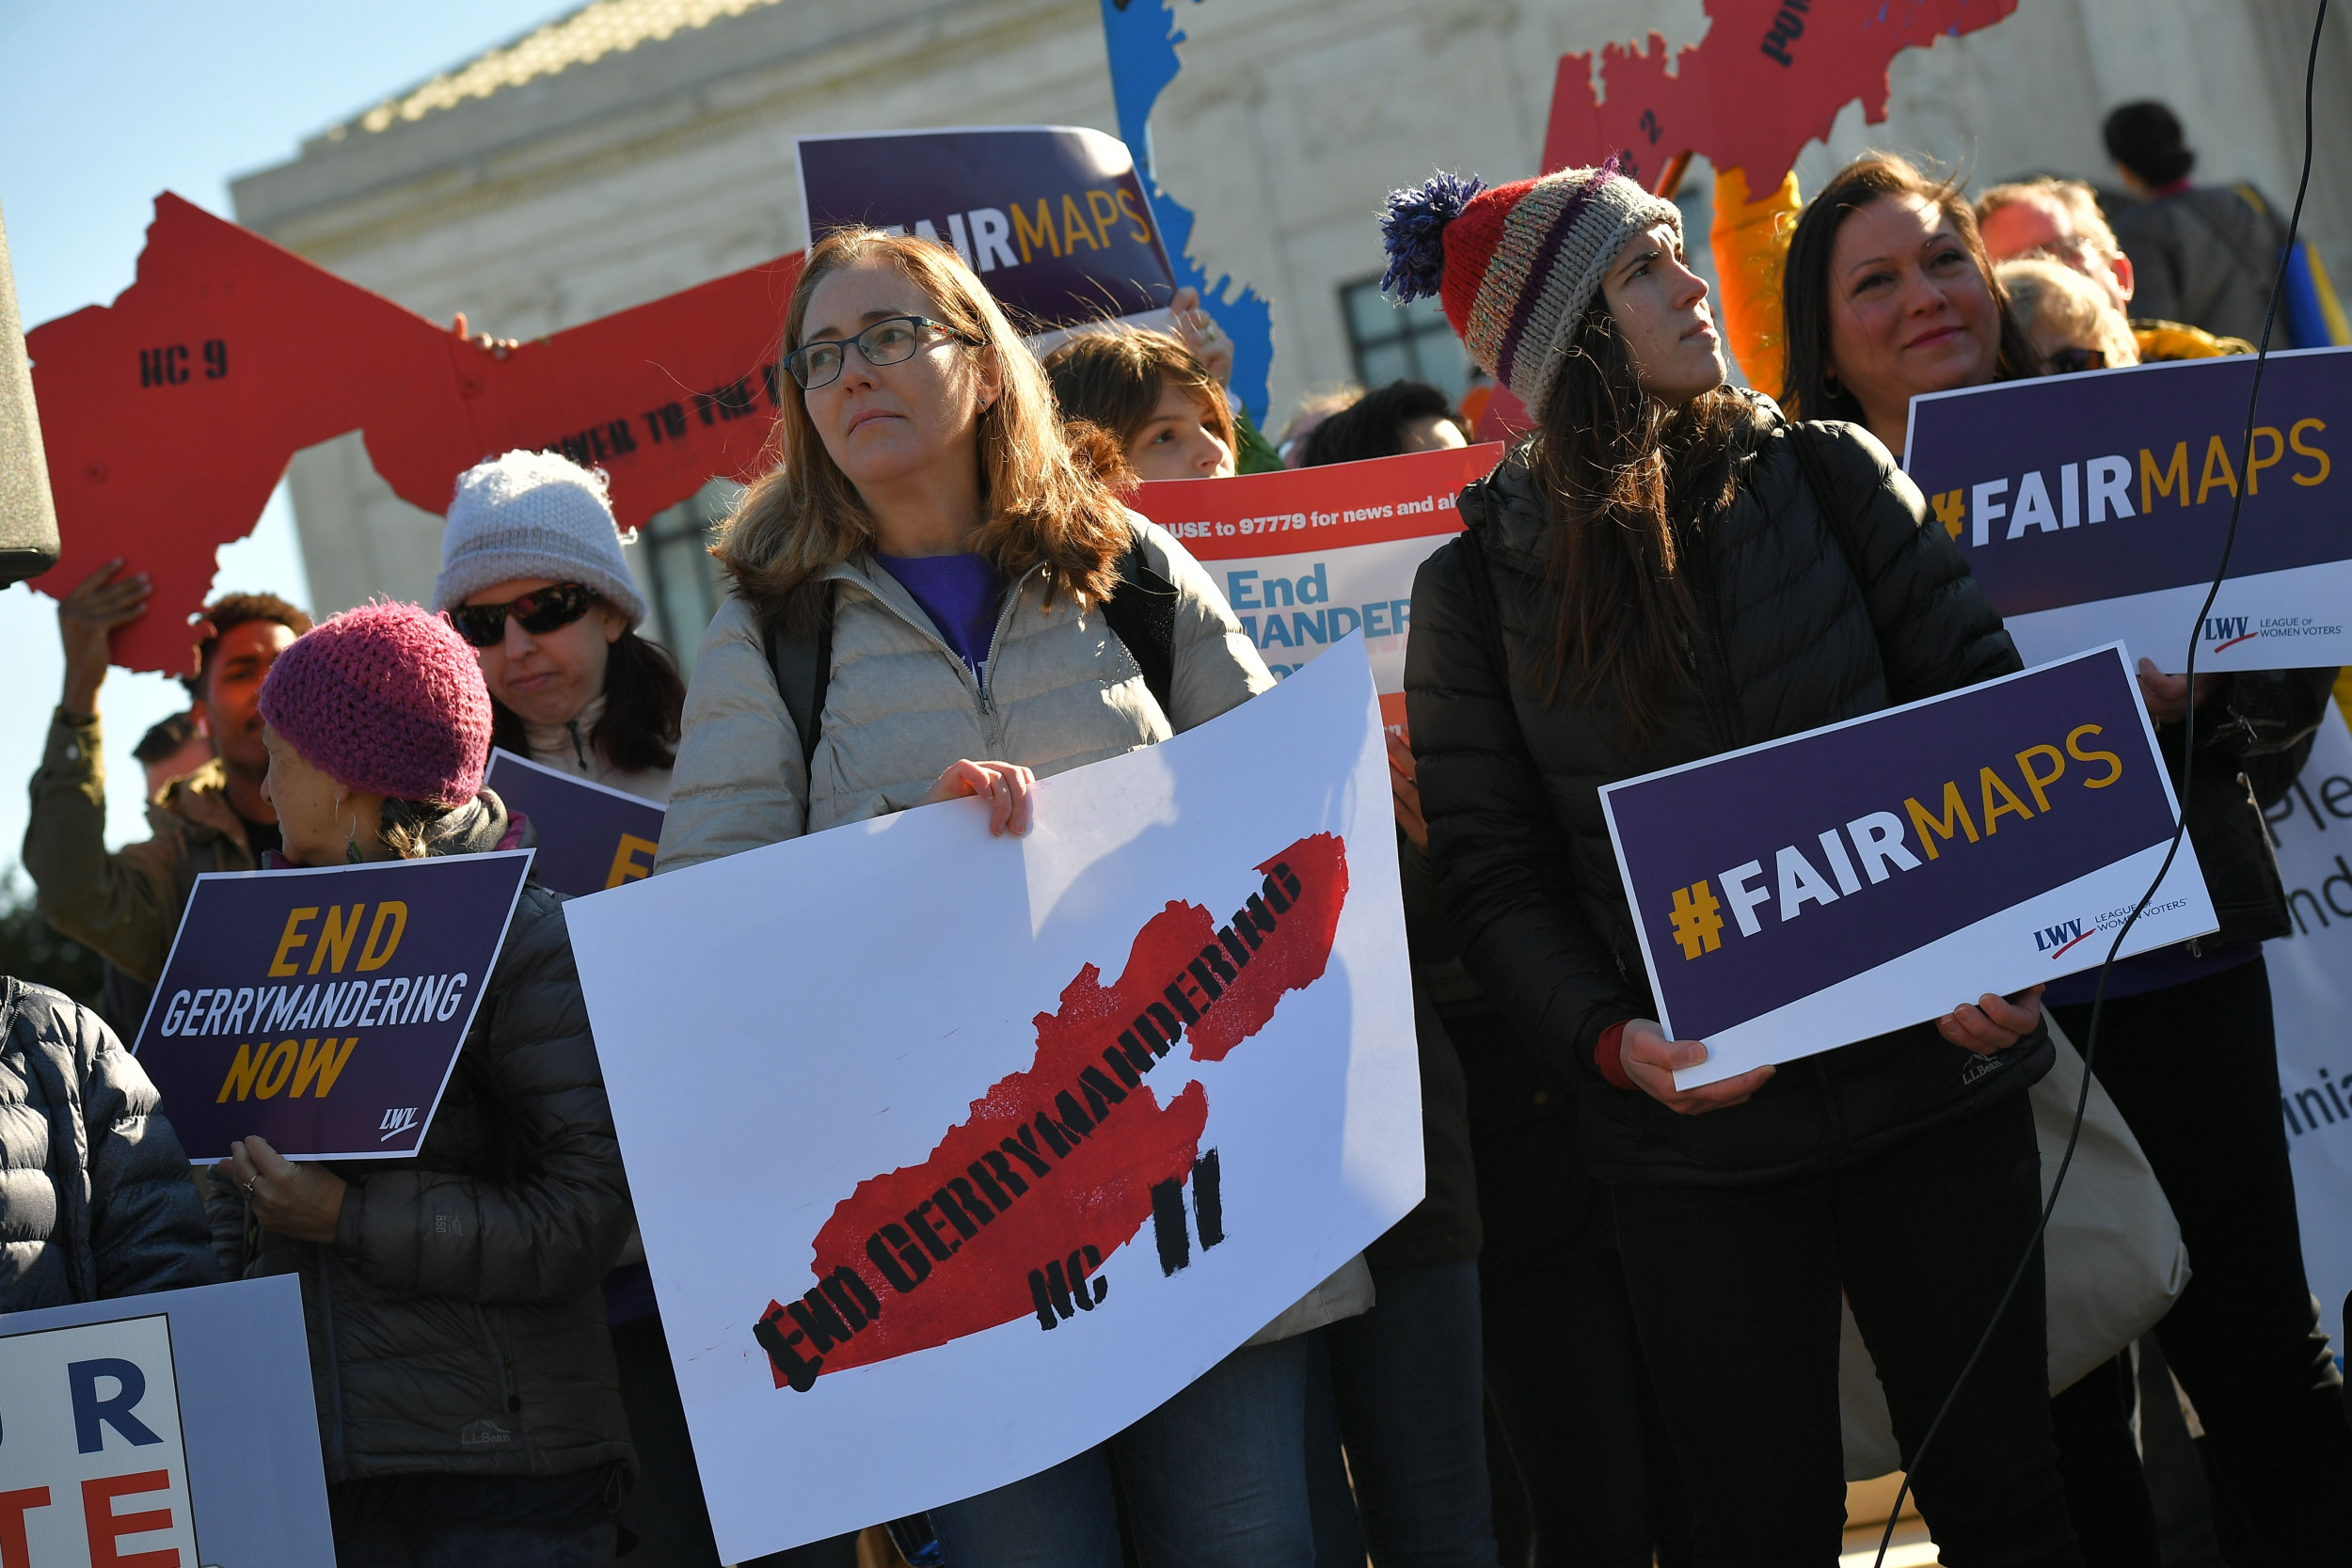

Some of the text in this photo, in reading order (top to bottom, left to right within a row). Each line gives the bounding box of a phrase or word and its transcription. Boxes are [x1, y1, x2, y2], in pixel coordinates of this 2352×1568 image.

[1640, 109, 1663, 145] 2
[886, 188, 1152, 274] AIRMAPS
[204, 339, 228, 379] 9
[548, 418, 637, 467] WER
[640, 402, 687, 444] TO
[694, 378, 758, 427] THE
[1931, 418, 2331, 547] #FAIRMAPS
[1158, 521, 1212, 539] USE
[1215, 521, 1236, 537] to
[1239, 512, 1307, 535] 97779
[1310, 510, 1340, 528] for
[1343, 504, 1393, 523] news
[1396, 495, 1434, 515] and
[1227, 562, 1329, 610] End
[2204, 616, 2249, 641] LWV
[2260, 617, 2313, 628] LEAGUE OF
[2260, 625, 2342, 639] WOMEN VOTERS
[1668, 723, 2123, 961] #FAIRMAPS
[2032, 917, 2082, 952] LWV
[2094, 903, 2137, 924] LEAGUE
[2096, 898, 2187, 932] WOMN VOTERS
[267, 900, 408, 977] END
[161, 972, 469, 1037] GERRYMANDERING
[216, 1037, 359, 1104] NOW
[378, 1107, 420, 1130] LWV
[753, 862, 1303, 1393] END GERRYMANDERING
[435, 1214, 447, 1233] 850
[1027, 1243, 1109, 1332] NC
[0, 1468, 181, 1568] TE
